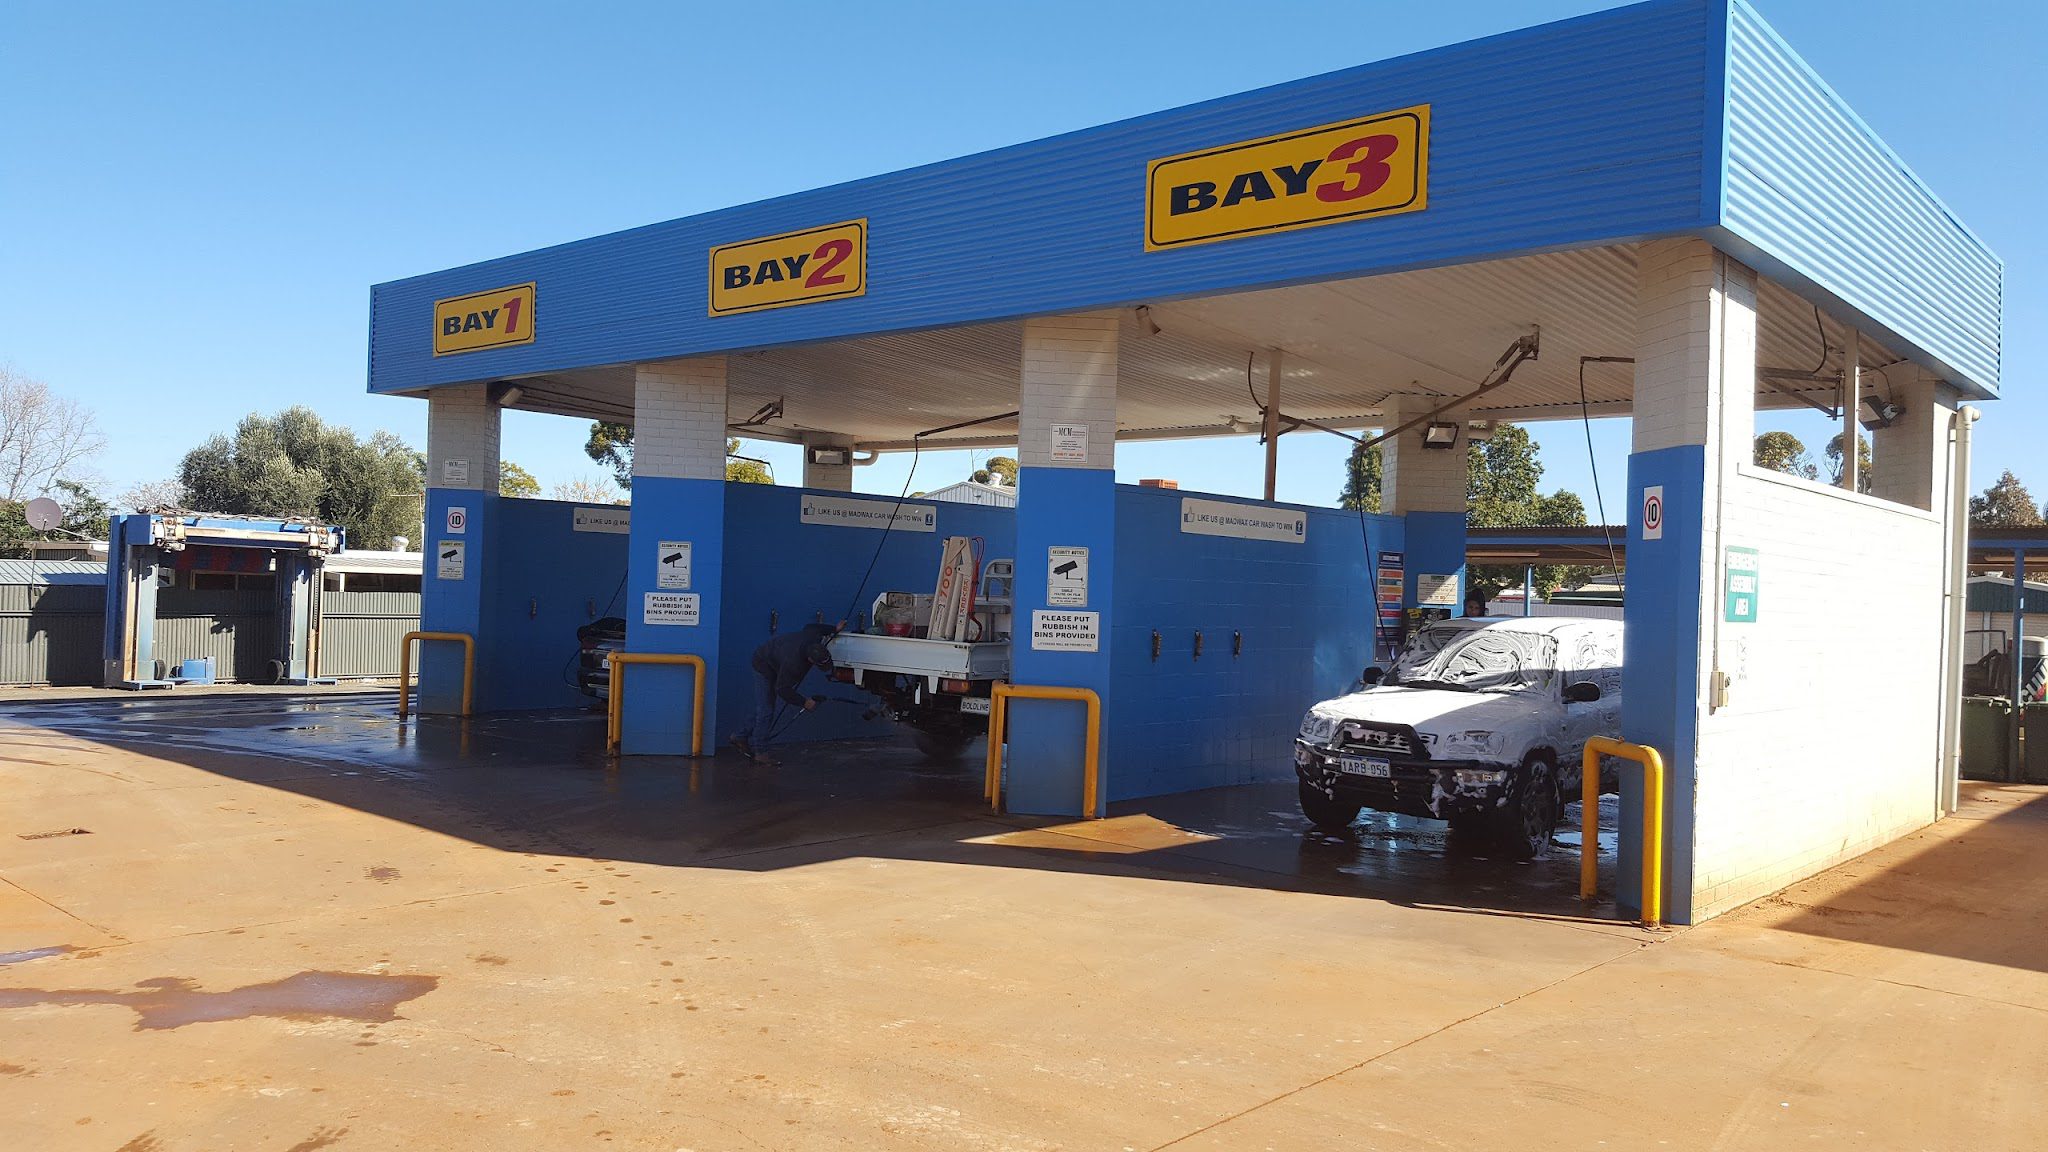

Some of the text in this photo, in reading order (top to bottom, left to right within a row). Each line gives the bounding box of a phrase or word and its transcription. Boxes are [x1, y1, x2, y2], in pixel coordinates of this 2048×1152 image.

[1170, 134, 1399, 216] BAY 3
[724, 238, 853, 290] BAY 2
[443, 297, 522, 336] BAY 1
[451, 515, 461, 525] 10
[1197, 514, 1210, 523] LIKE
[1210, 515, 1218, 523] US
[1248, 519, 1260, 528] CAR
[1648, 503, 1657, 522] 10
[962, 701, 989, 711] BOLDLINE
